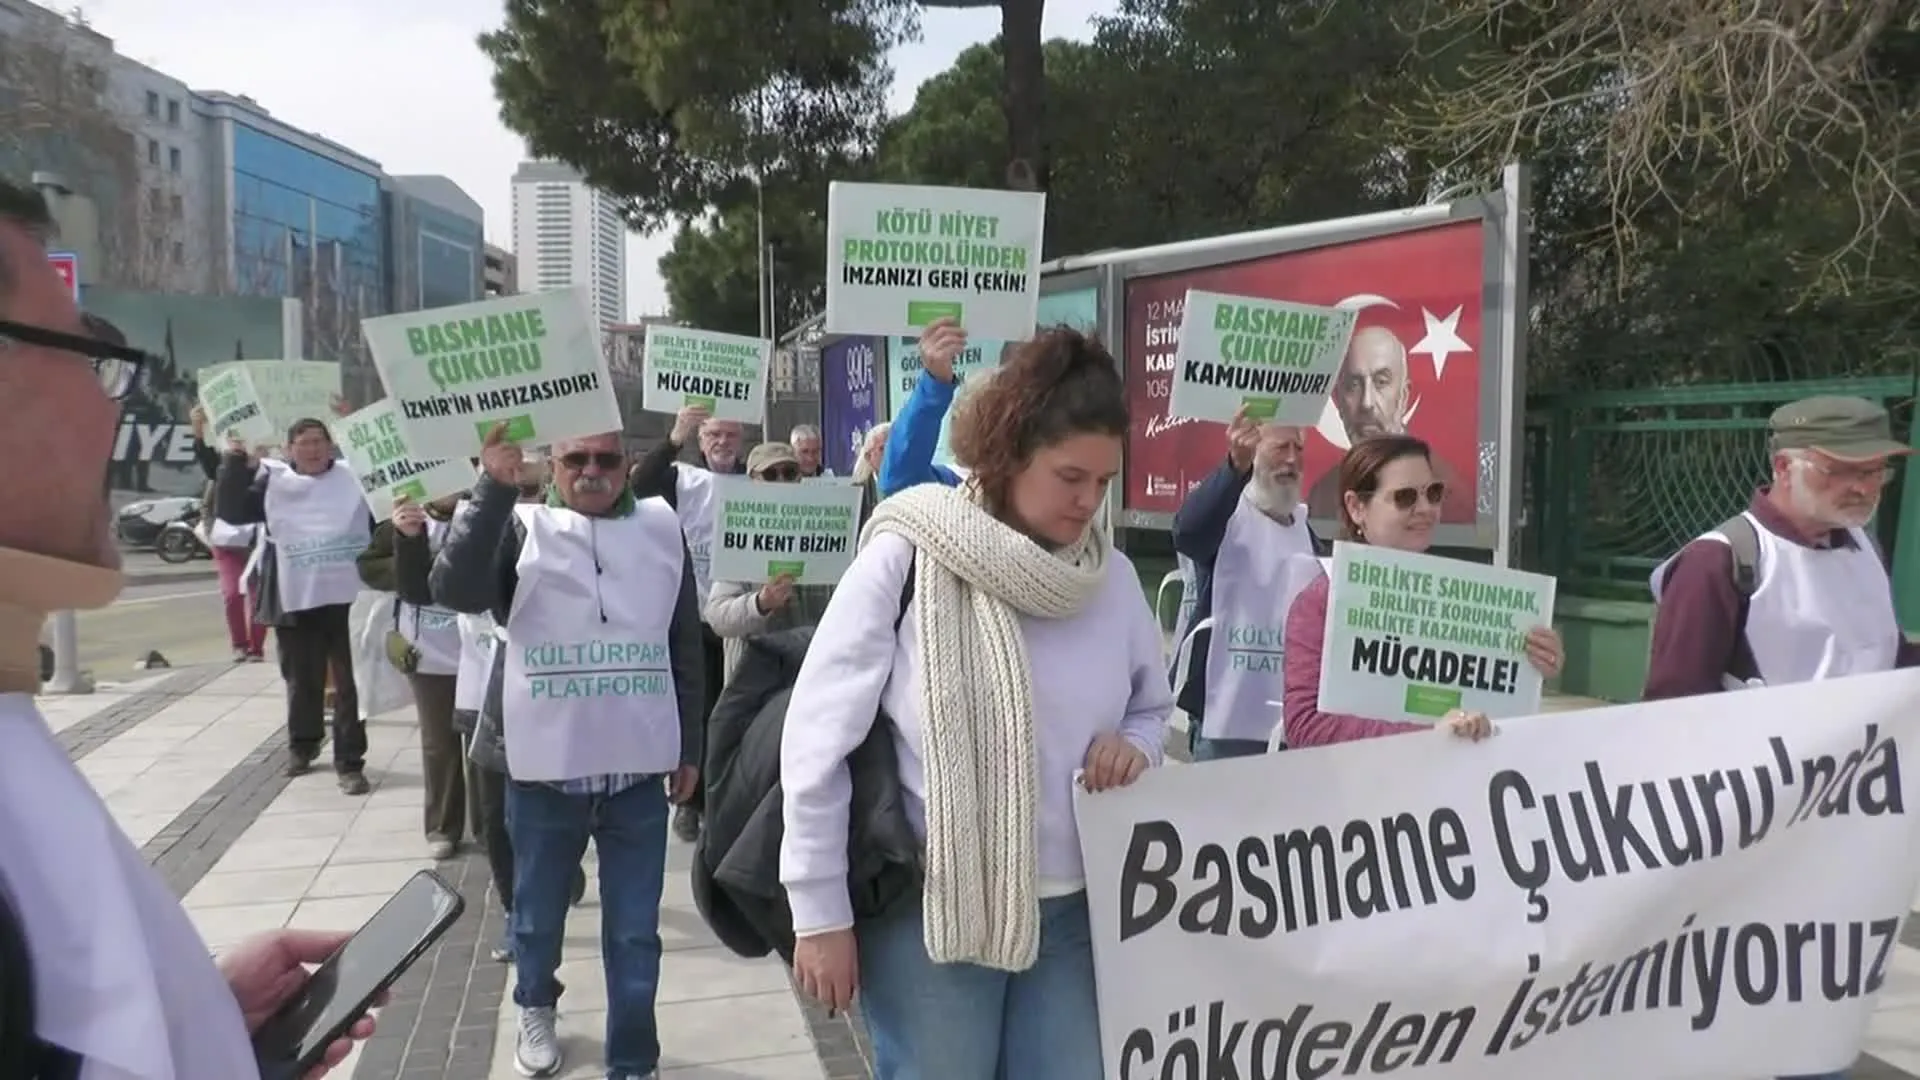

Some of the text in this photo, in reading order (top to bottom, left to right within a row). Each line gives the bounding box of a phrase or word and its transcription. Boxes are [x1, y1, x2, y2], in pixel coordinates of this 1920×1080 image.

[876, 207, 999, 238] KÖTÜ NİYET
[844, 239, 1026, 270] PROTOKOLÜNDEN
[843, 262, 1026, 294] İMZANIZI GERİ ÇEKİN!
[1147, 299, 1184, 320] 12 MA
[1214, 303, 1330, 340] BASMANE
[407, 309, 546, 355] BASMANE
[428, 343, 542, 391] ÇUKURU
[1146, 353, 1175, 372] KAB
[1219, 332, 1316, 369] ÇUKURU
[402, 372, 599, 419] İZMİR'İN HAFIZASIDIR!
[657, 370, 750, 400] MÜCADELE!
[1184, 360, 1332, 395] KAMUNUNDUR!
[726, 516, 755, 528] BUCA
[724, 532, 847, 552] BU KENT BİZİM!
[1348, 560, 1540, 615] BİRLİKTE SAVUNMAK,
[1347, 607, 1414, 635] BİRLİKTE
[1419, 620, 1501, 649] KAZANMAK
[1370, 591, 1517, 632] BİRLİKTE KORUMAK,
[1233, 655, 1284, 673] PLAT
[1351, 635, 1519, 694] MÜCADELE!
[1121, 724, 1905, 942] Basmane Çukuru'nda
